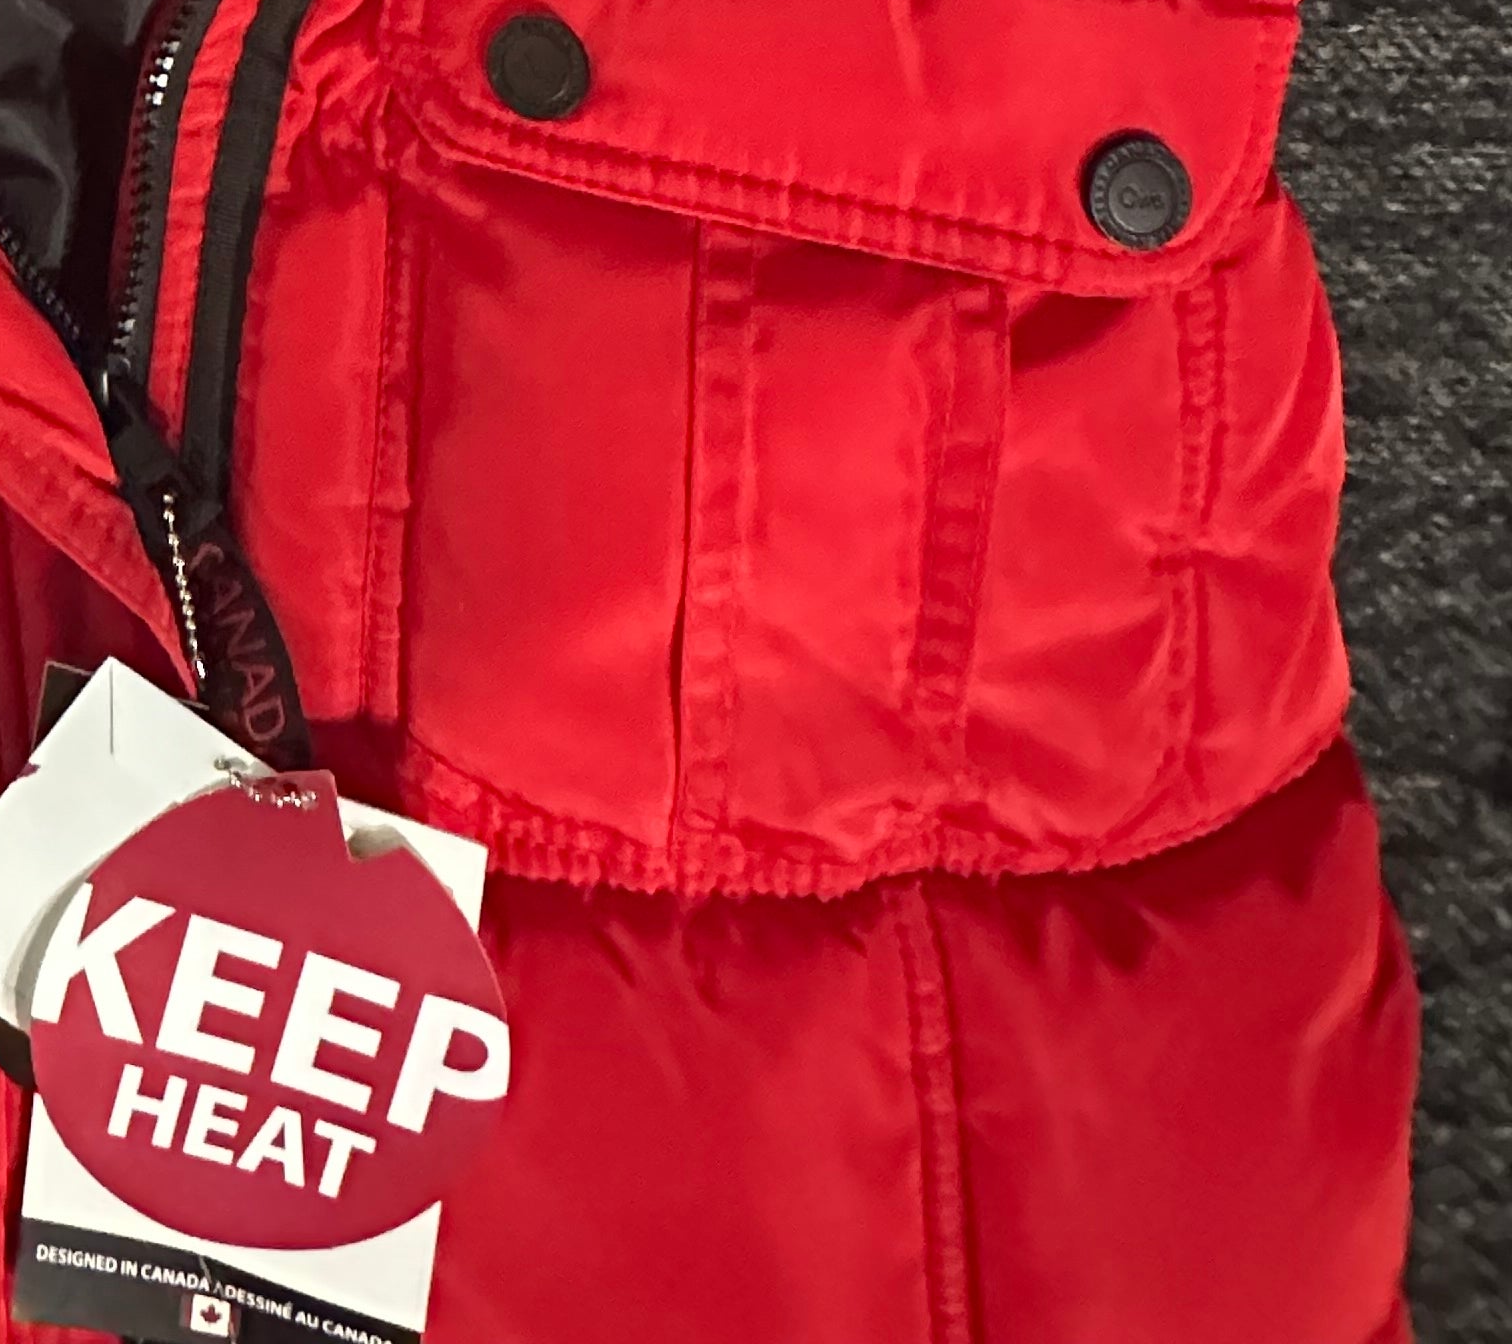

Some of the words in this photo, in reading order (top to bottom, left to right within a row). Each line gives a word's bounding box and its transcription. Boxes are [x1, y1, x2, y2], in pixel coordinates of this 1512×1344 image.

[30, 882, 510, 1133] KEEP
[107, 1063, 376, 1198] HEAT
[36, 1243, 118, 1273] DESIGNED
[120, 1260, 138, 1277] IN
[140, 1263, 210, 1293] CANADA
[224, 1284, 293, 1320] DESSINÉ
[294, 1310, 320, 1330] AU
